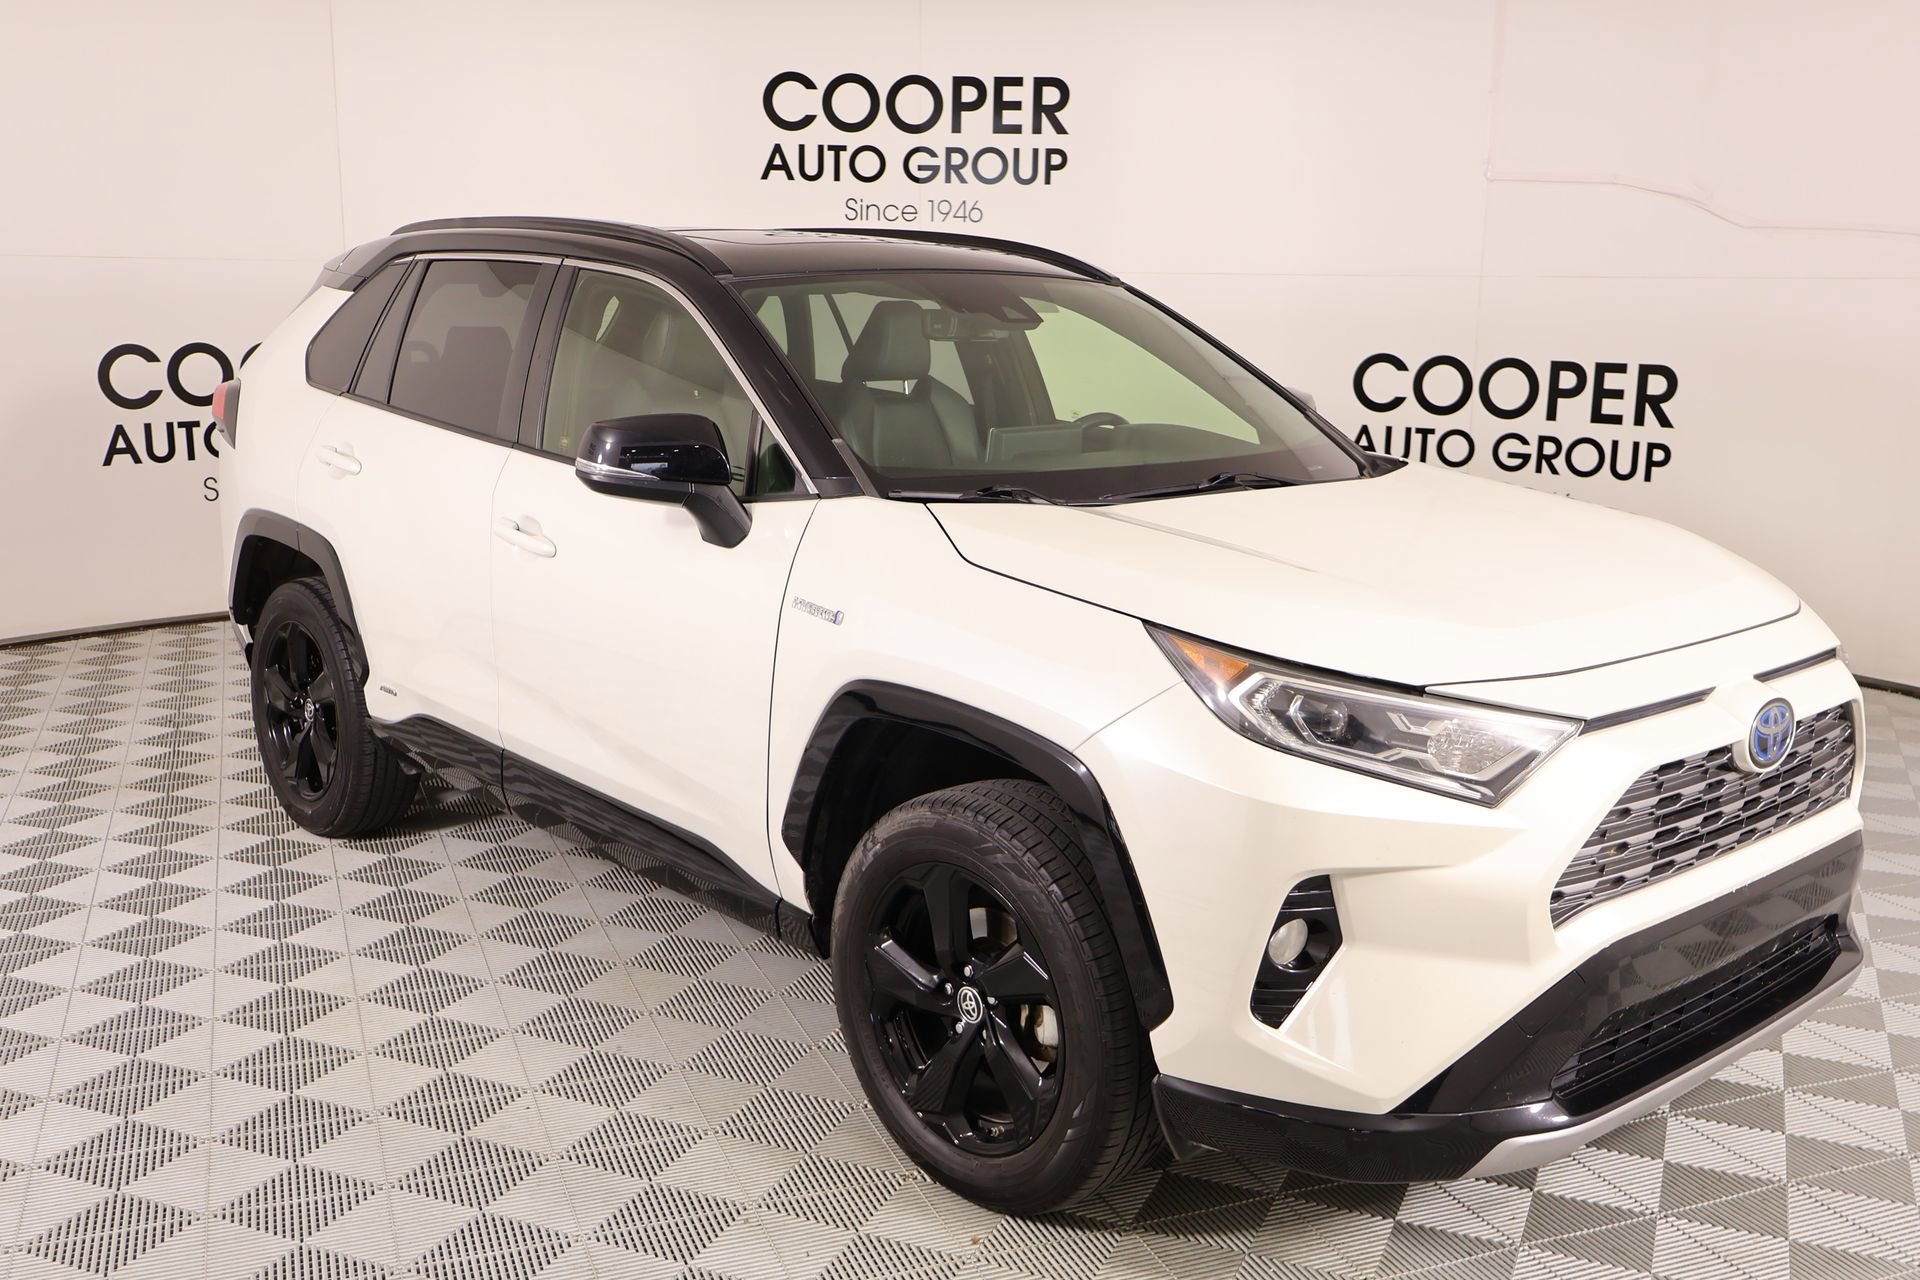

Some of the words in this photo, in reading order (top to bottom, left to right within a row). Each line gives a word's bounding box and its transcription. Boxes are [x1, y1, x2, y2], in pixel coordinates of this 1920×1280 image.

[762, 71, 1070, 135] COOPER
[760, 143, 887, 183] AUTO
[903, 146, 1068, 186] GROUP
[845, 198, 919, 222] Since
[927, 200, 983, 223] 1946
[97, 341, 263, 410] CO
[1353, 352, 1679, 429] COOPER
[1354, 424, 1476, 468] AUTO
[1492, 432, 1672, 483] GROUP
